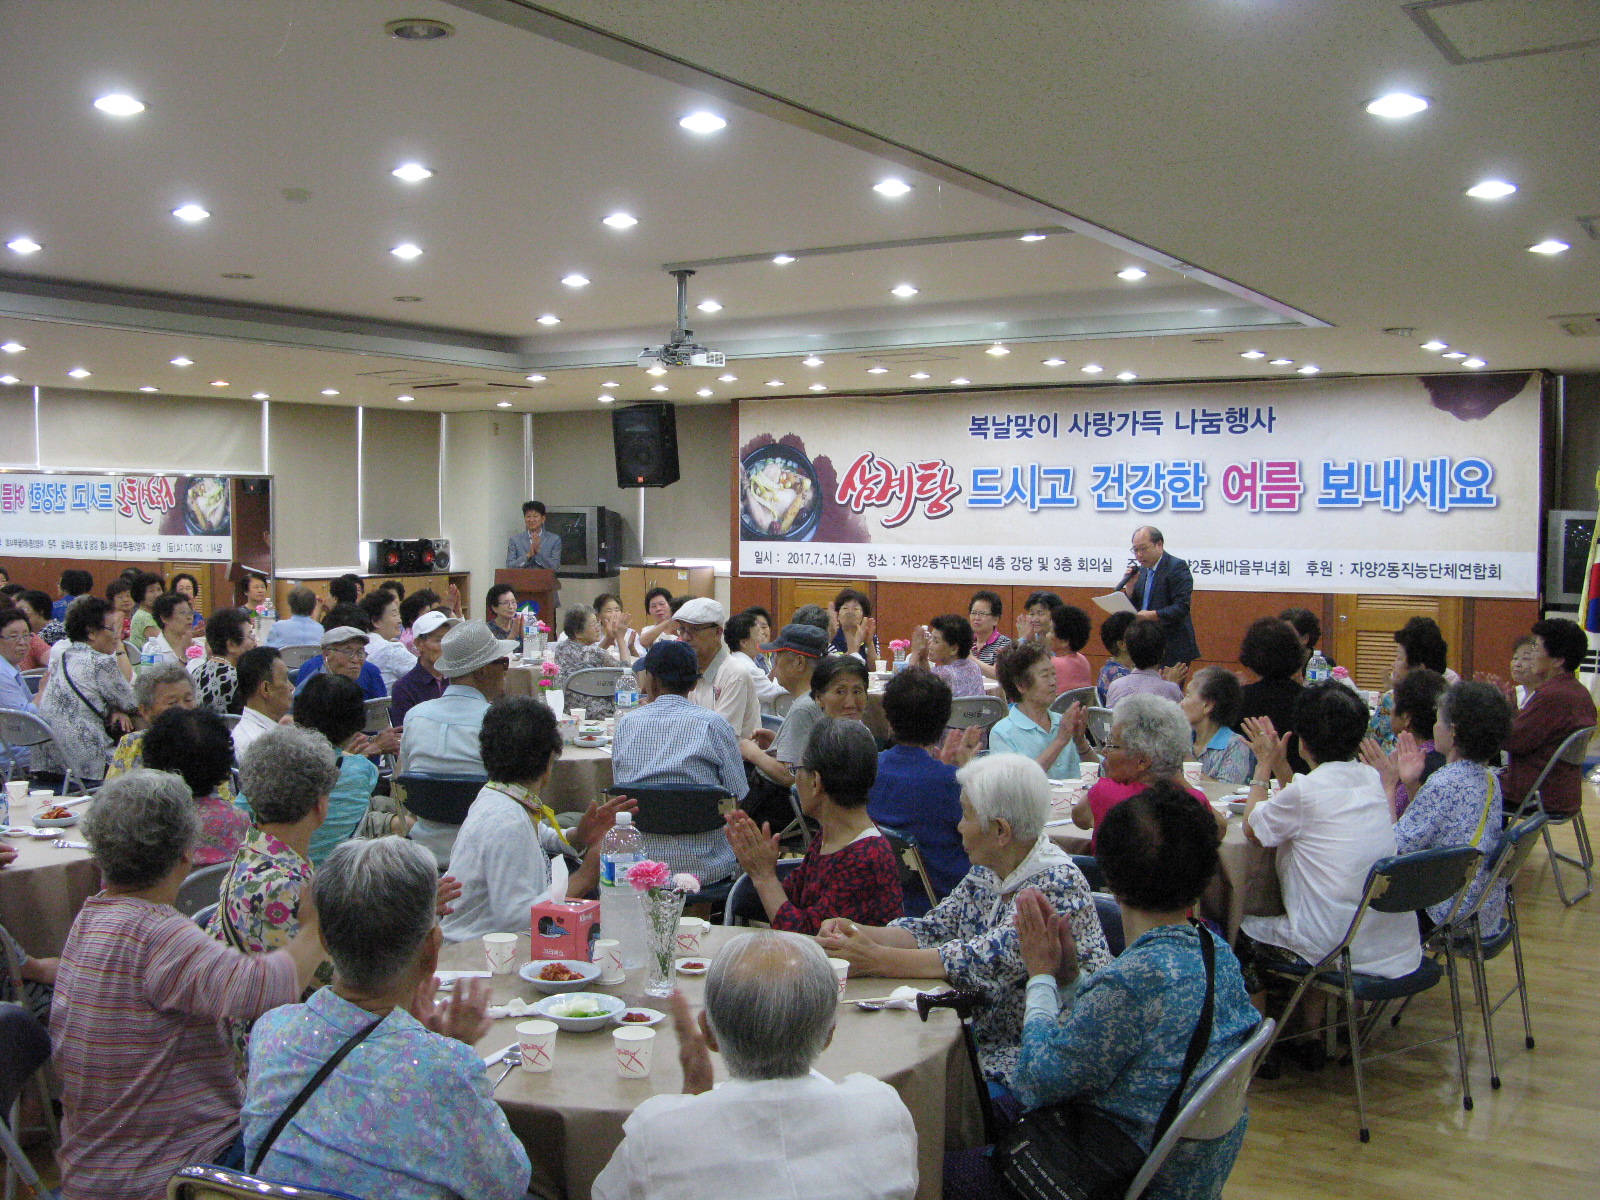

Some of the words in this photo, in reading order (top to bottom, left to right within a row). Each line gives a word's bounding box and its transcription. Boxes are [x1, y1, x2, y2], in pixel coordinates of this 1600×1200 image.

[968, 413, 1058, 440] 복날맞이
[1068, 410, 1164, 438] 사랑가득
[1175, 406, 1277, 435] 나눔행사
[837, 451, 961, 527] 삼계탕
[967, 463, 1077, 511] 드시고
[1090, 461, 1206, 512] 건강한
[1222, 459, 1302, 512] 여름
[1318, 456, 1496, 511] 보내세요
[754, 551, 773, 564] 일시
[787, 551, 855, 567] 2017.7.14.(금)
[867, 553, 887, 568] 장소
[900, 554, 983, 571] 자양2동주민센터
[987, 555, 1006, 571] 4층
[1010, 556, 1034, 572] 강당
[1037, 556, 1049, 572] 및
[1053, 556, 1073, 573] 3층
[1077, 557, 1112, 573] 회의실
[1188, 559, 1290, 577] 2동새마을부녀회
[1305, 560, 1333, 577] 후원
[1350, 561, 1502, 581] 자양2동직능단체연합회
